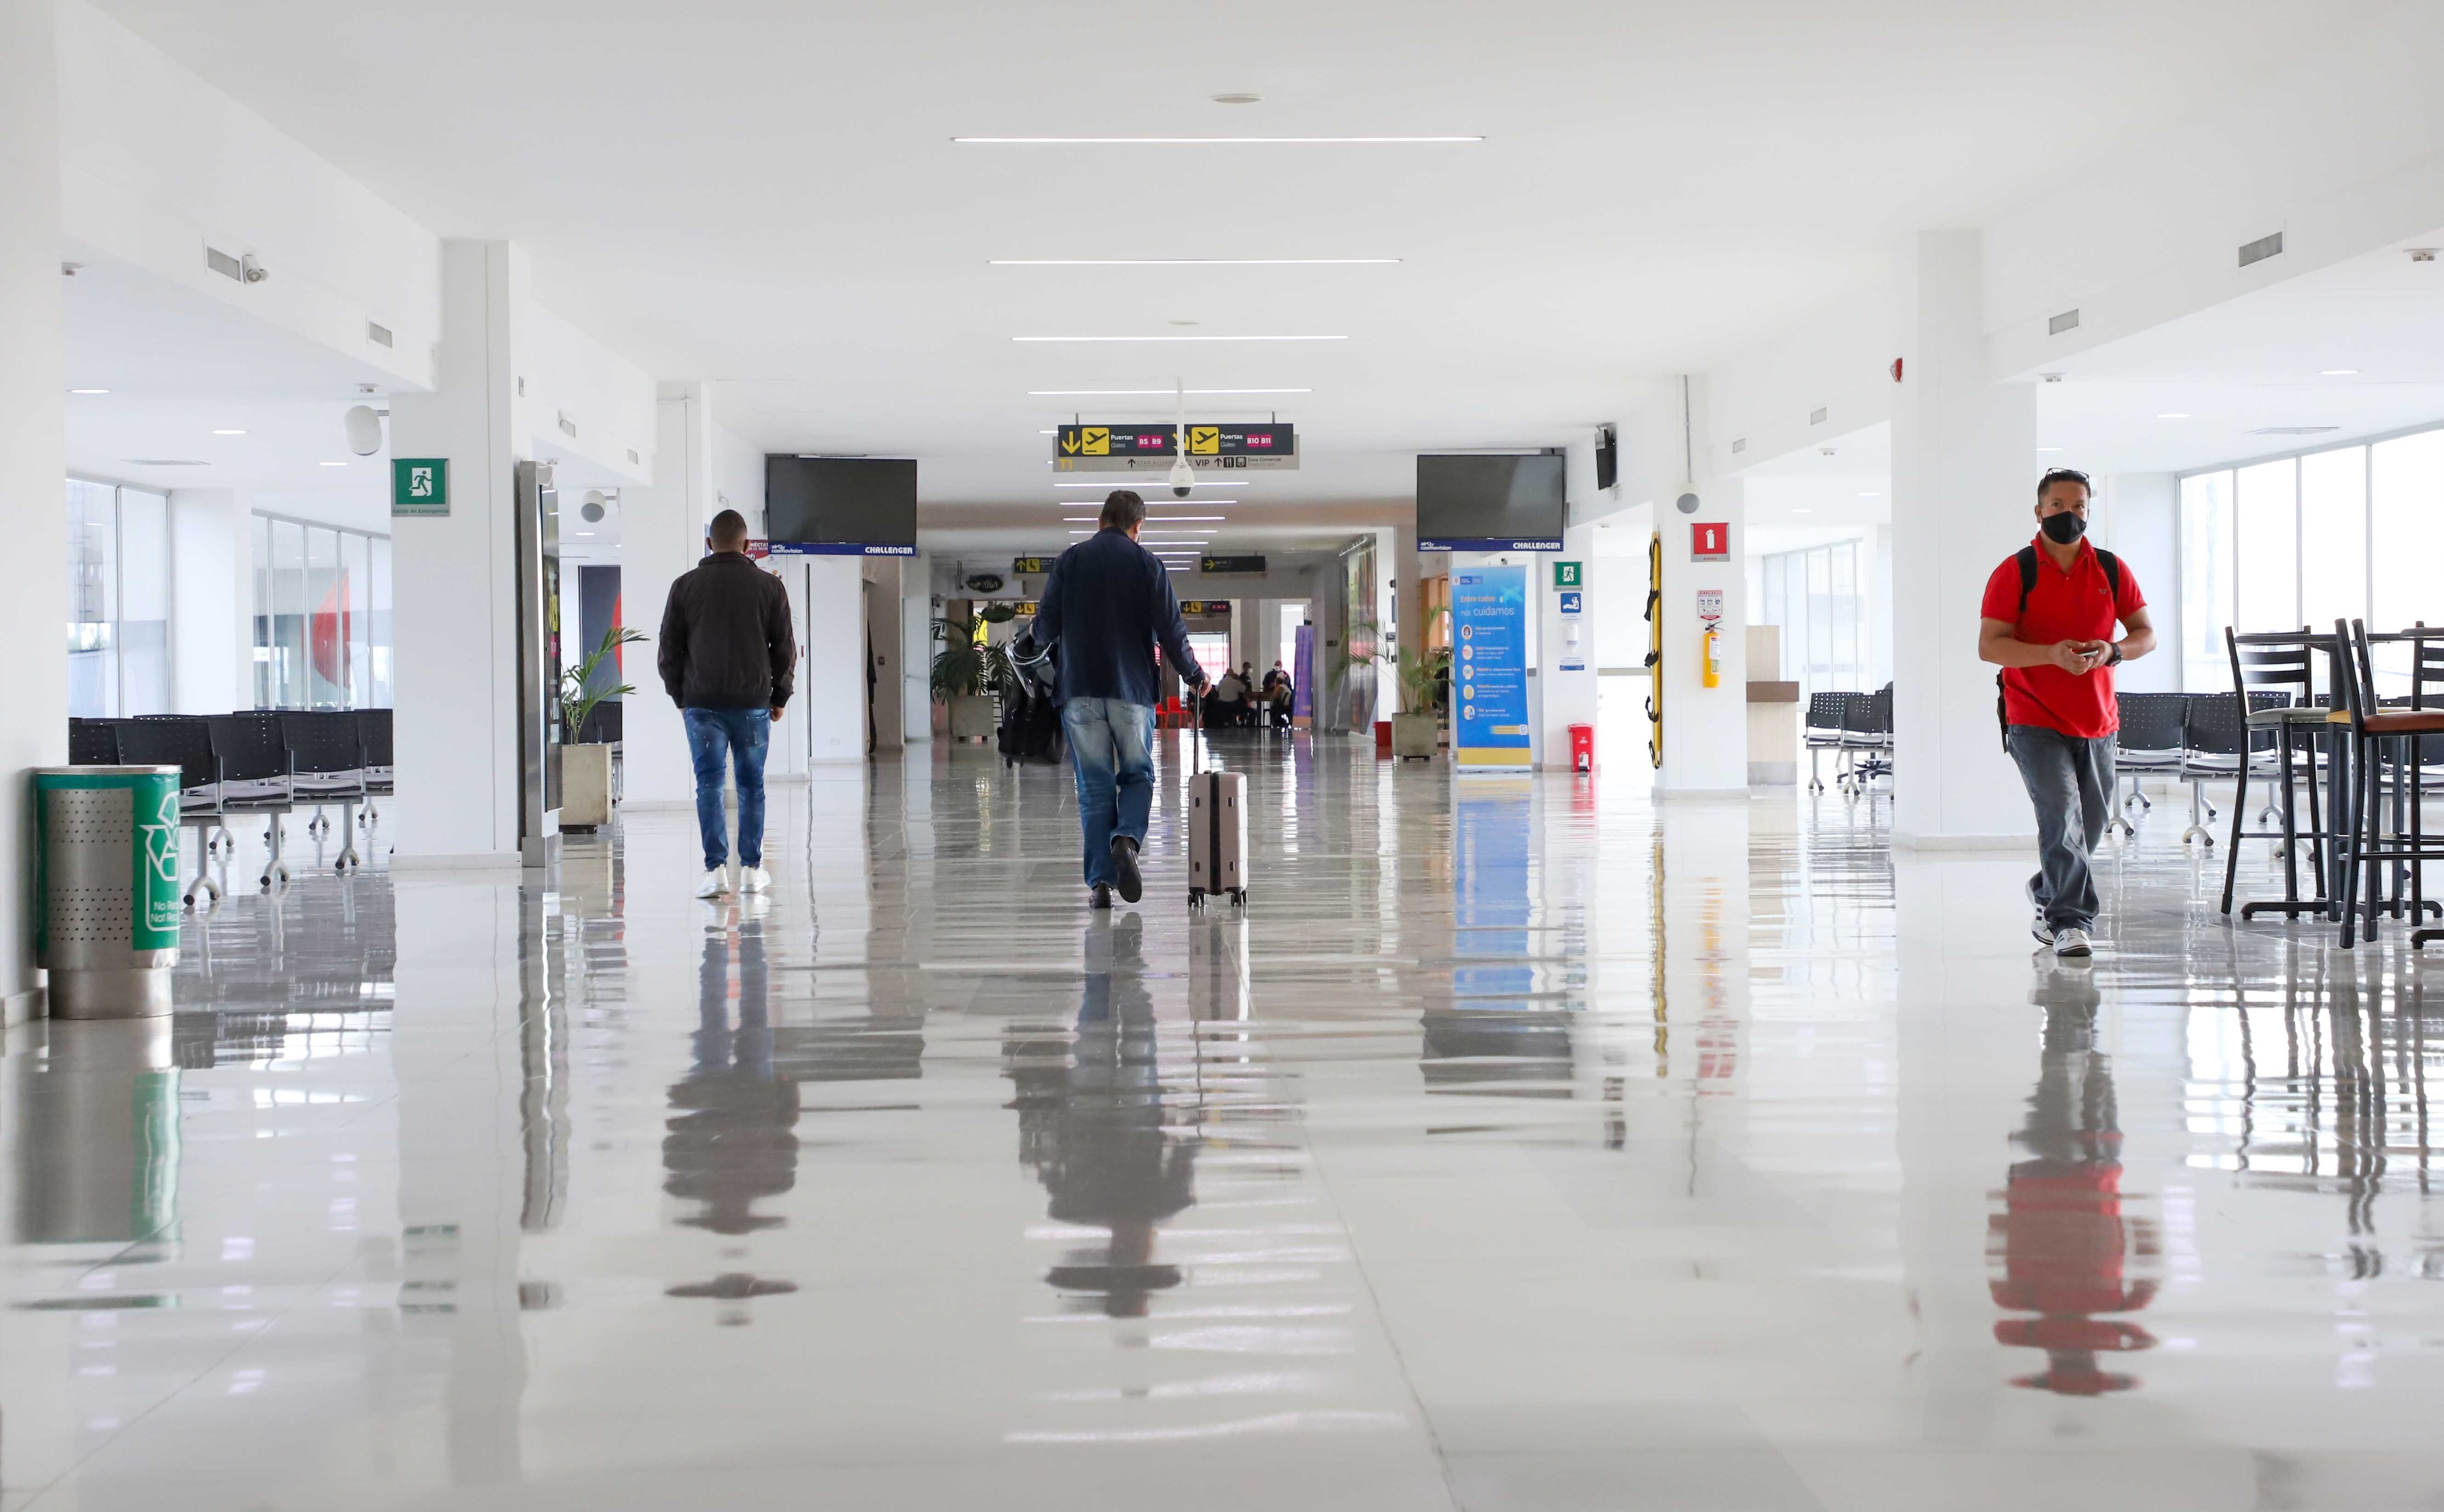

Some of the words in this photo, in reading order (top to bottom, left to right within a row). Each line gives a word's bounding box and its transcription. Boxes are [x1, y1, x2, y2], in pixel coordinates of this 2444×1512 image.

[1473, 606, 1515, 616] cuidamos
[154, 901, 166, 910] No
[150, 913, 165, 923] Not
